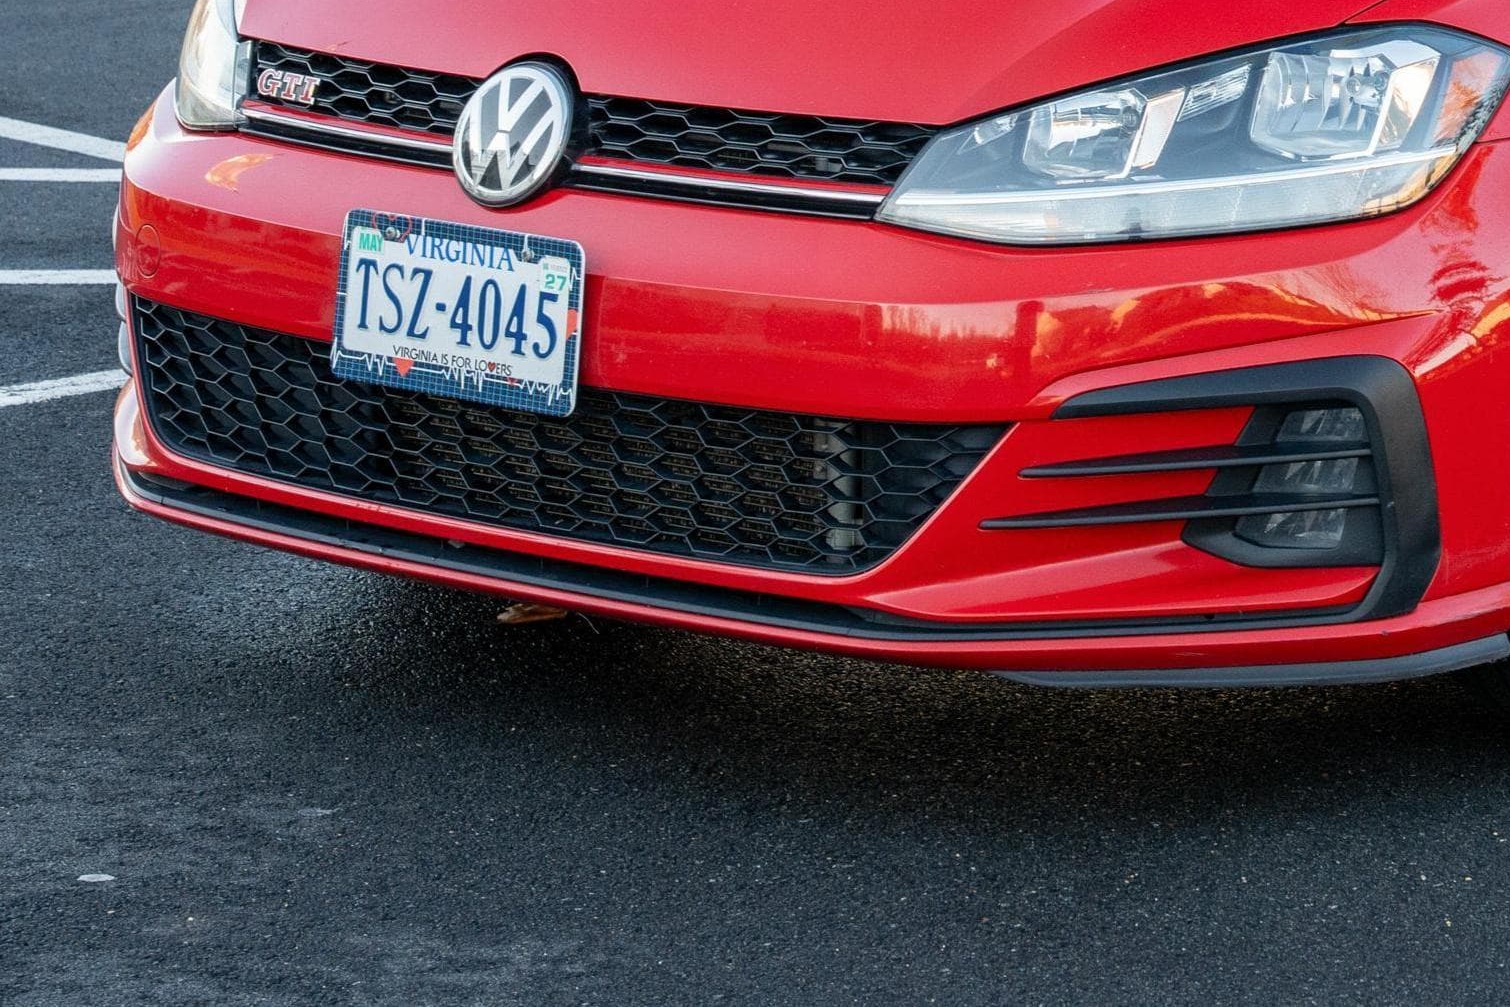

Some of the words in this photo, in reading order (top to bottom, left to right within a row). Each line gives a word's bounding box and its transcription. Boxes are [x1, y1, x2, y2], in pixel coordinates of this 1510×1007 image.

[257, 67, 321, 106] GTI
[358, 232, 383, 252] MAY
[405, 234, 515, 272] VIRGINIA
[544, 273, 567, 291] 27
[355, 257, 559, 359] TSZ-4045
[392, 344, 439, 363] VIRGINIA
[441, 353, 448, 365] IS
[451, 355, 471, 369] FOR
